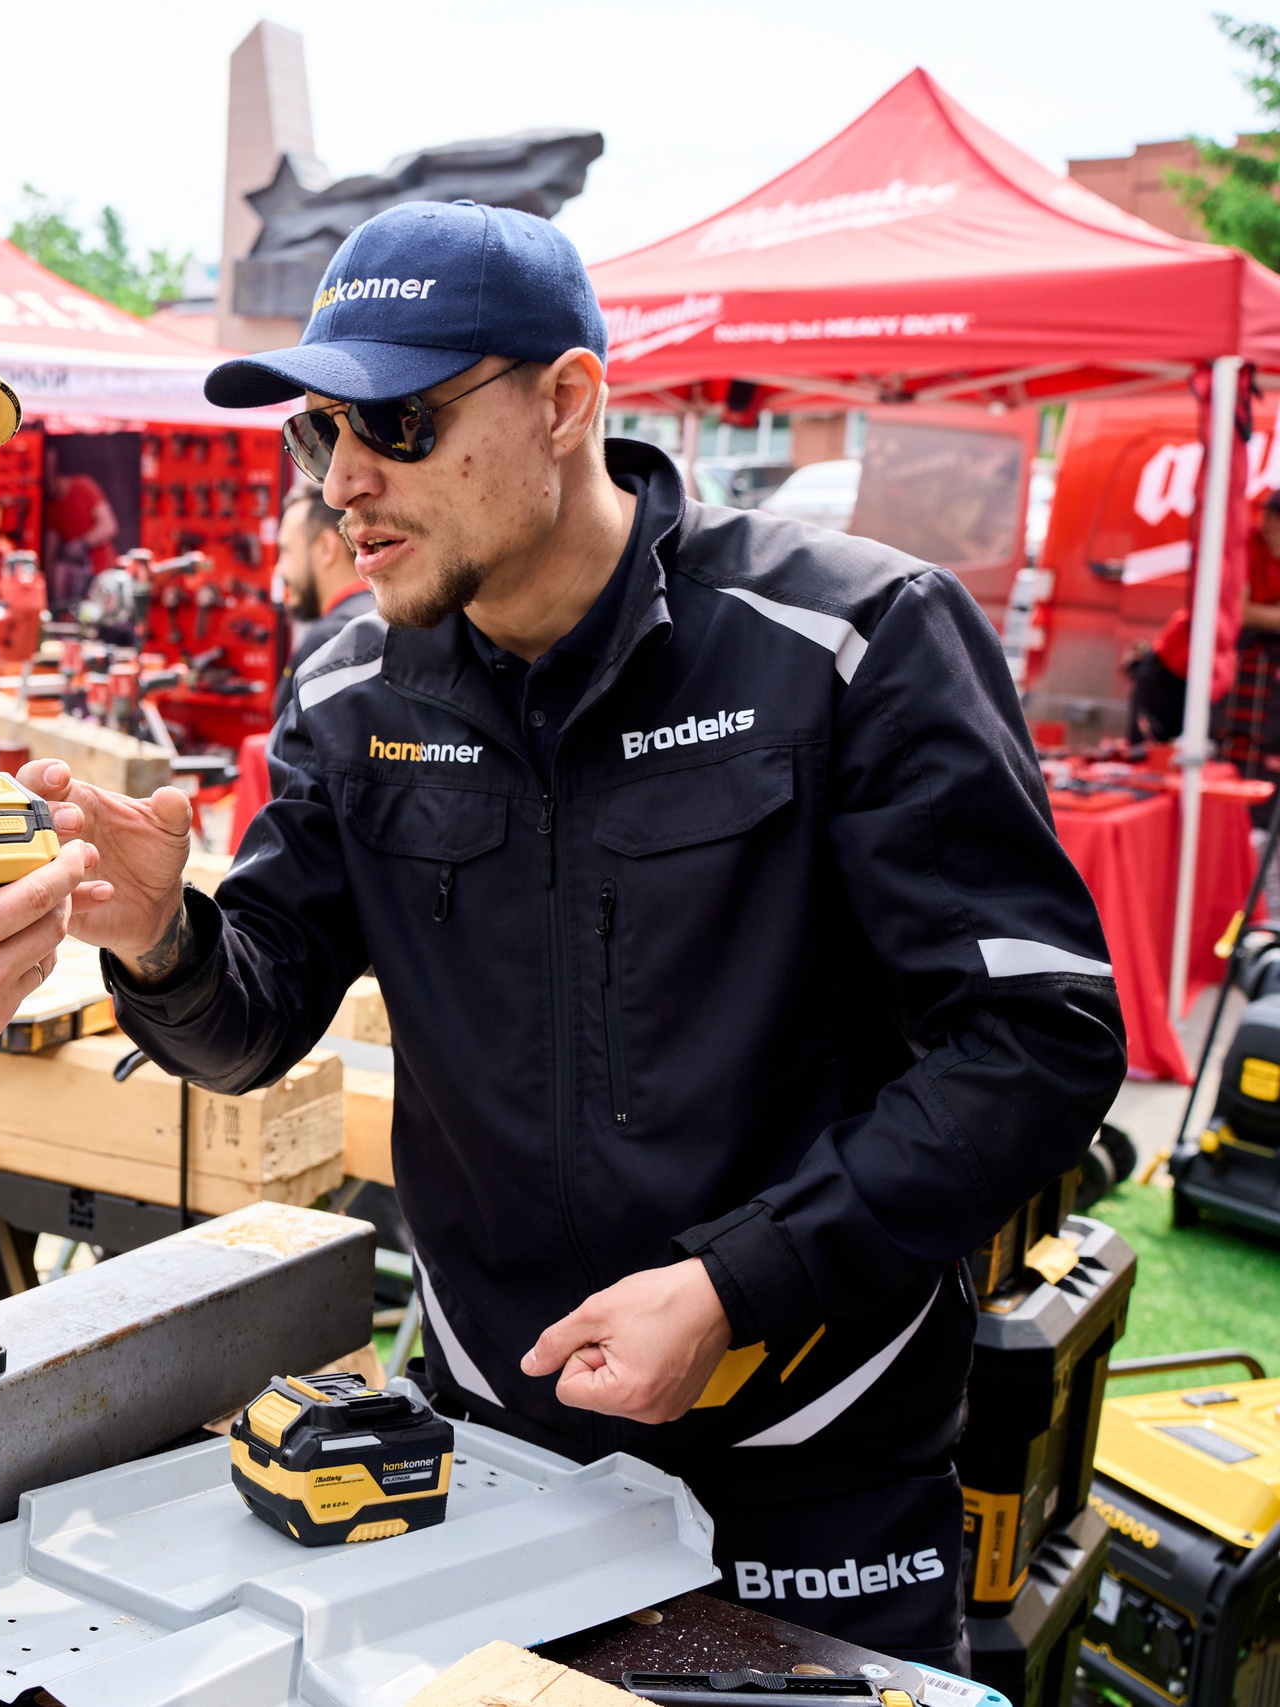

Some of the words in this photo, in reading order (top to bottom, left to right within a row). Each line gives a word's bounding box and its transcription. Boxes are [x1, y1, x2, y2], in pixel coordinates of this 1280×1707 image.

[621, 708, 755, 760] Brodeks
[382, 1458, 435, 1472] hanskonner
[384, 1474, 411, 1483] PLATINUM
[734, 1547, 945, 1599] Brodeks
